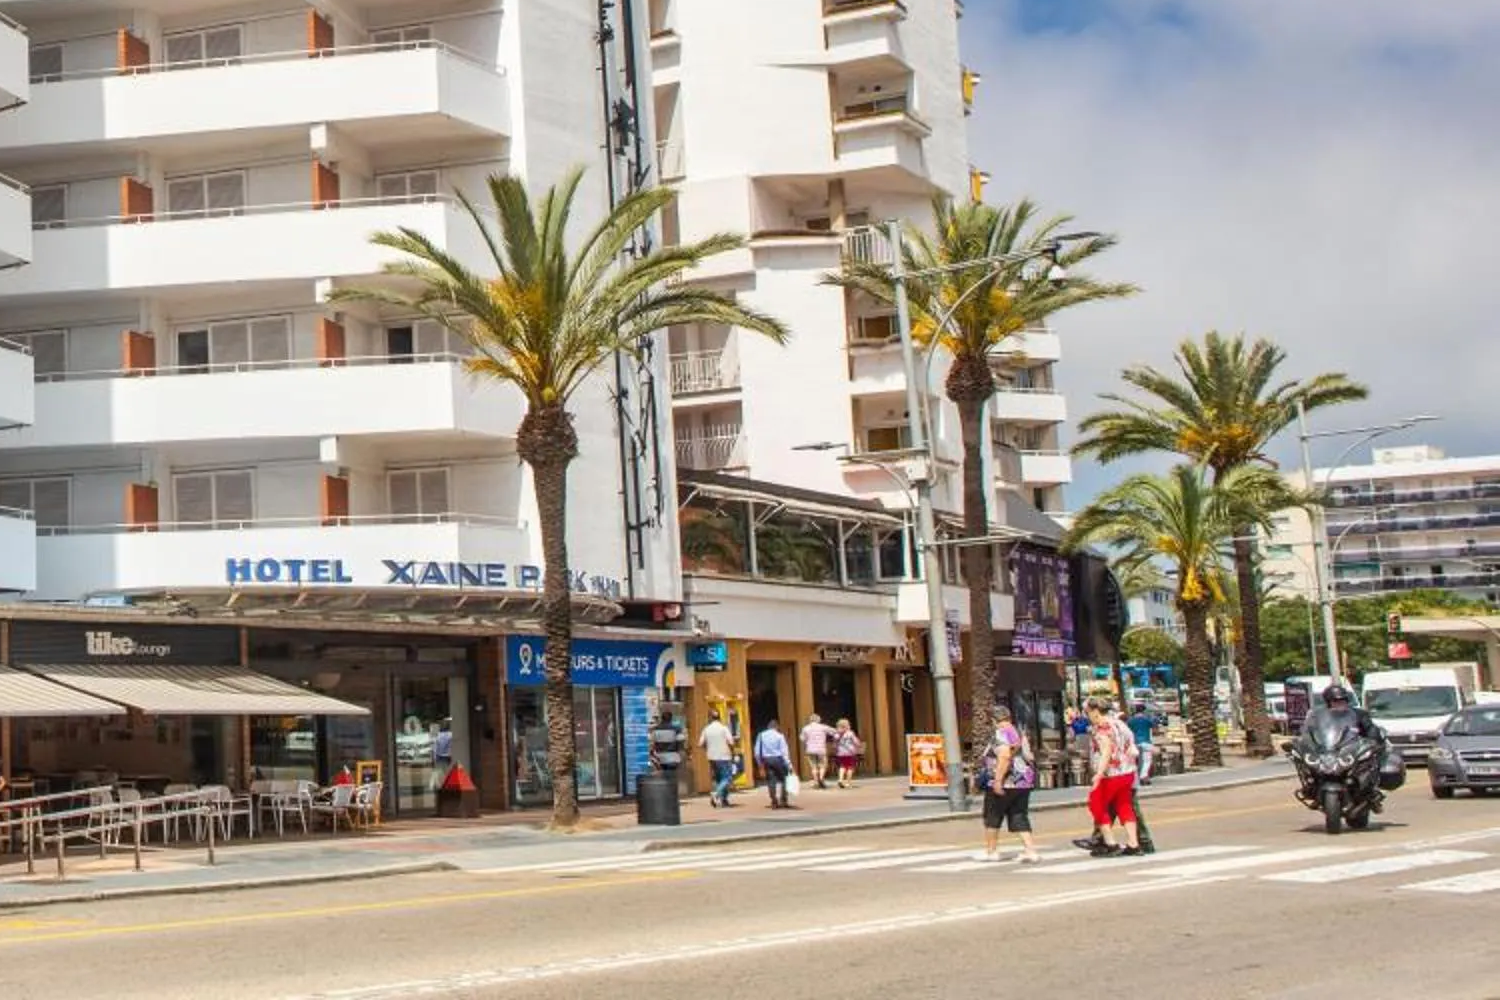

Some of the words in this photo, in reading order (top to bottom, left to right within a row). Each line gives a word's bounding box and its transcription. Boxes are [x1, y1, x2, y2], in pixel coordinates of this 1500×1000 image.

[225, 557, 353, 583] HOTEL
[381, 559, 507, 587] XAINE
[607, 655, 650, 672] TICKETS
